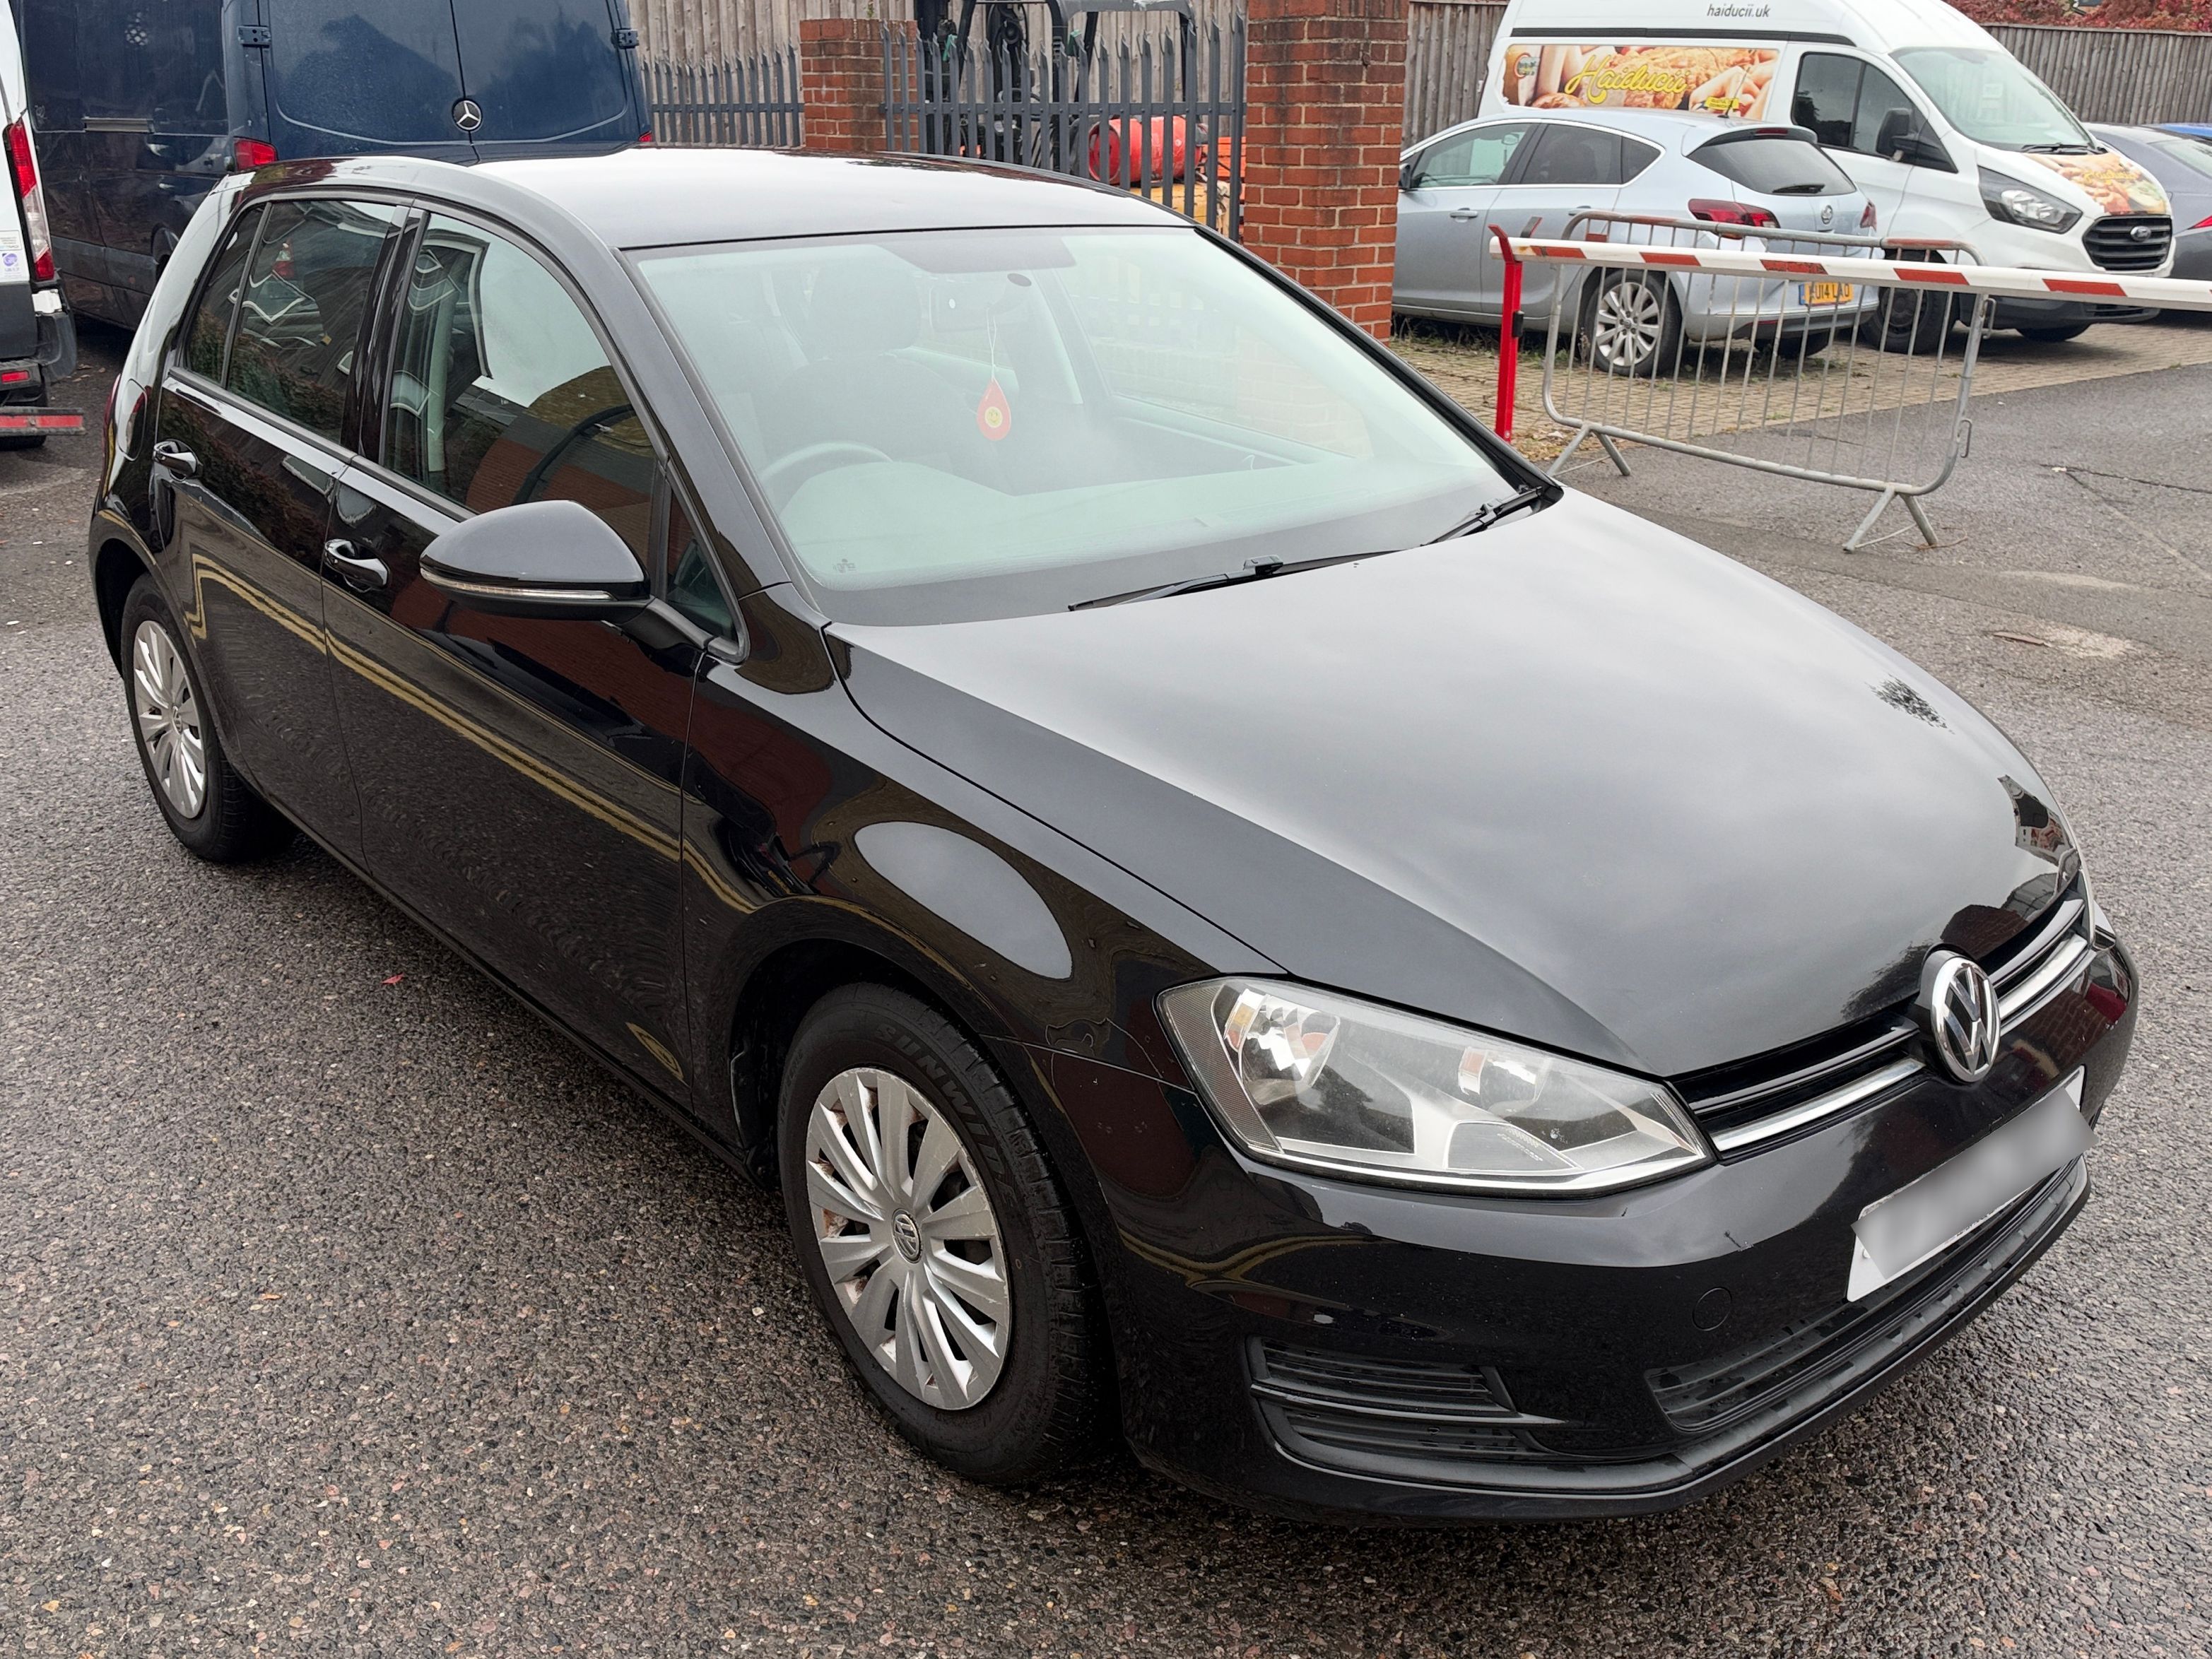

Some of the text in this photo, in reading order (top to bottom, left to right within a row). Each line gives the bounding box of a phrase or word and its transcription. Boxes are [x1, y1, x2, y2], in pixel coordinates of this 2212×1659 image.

[1707, 4, 1770, 18] haiducii.uk
[1564, 54, 1690, 105] Haiducii
[1808, 283, 1830, 300] U14
